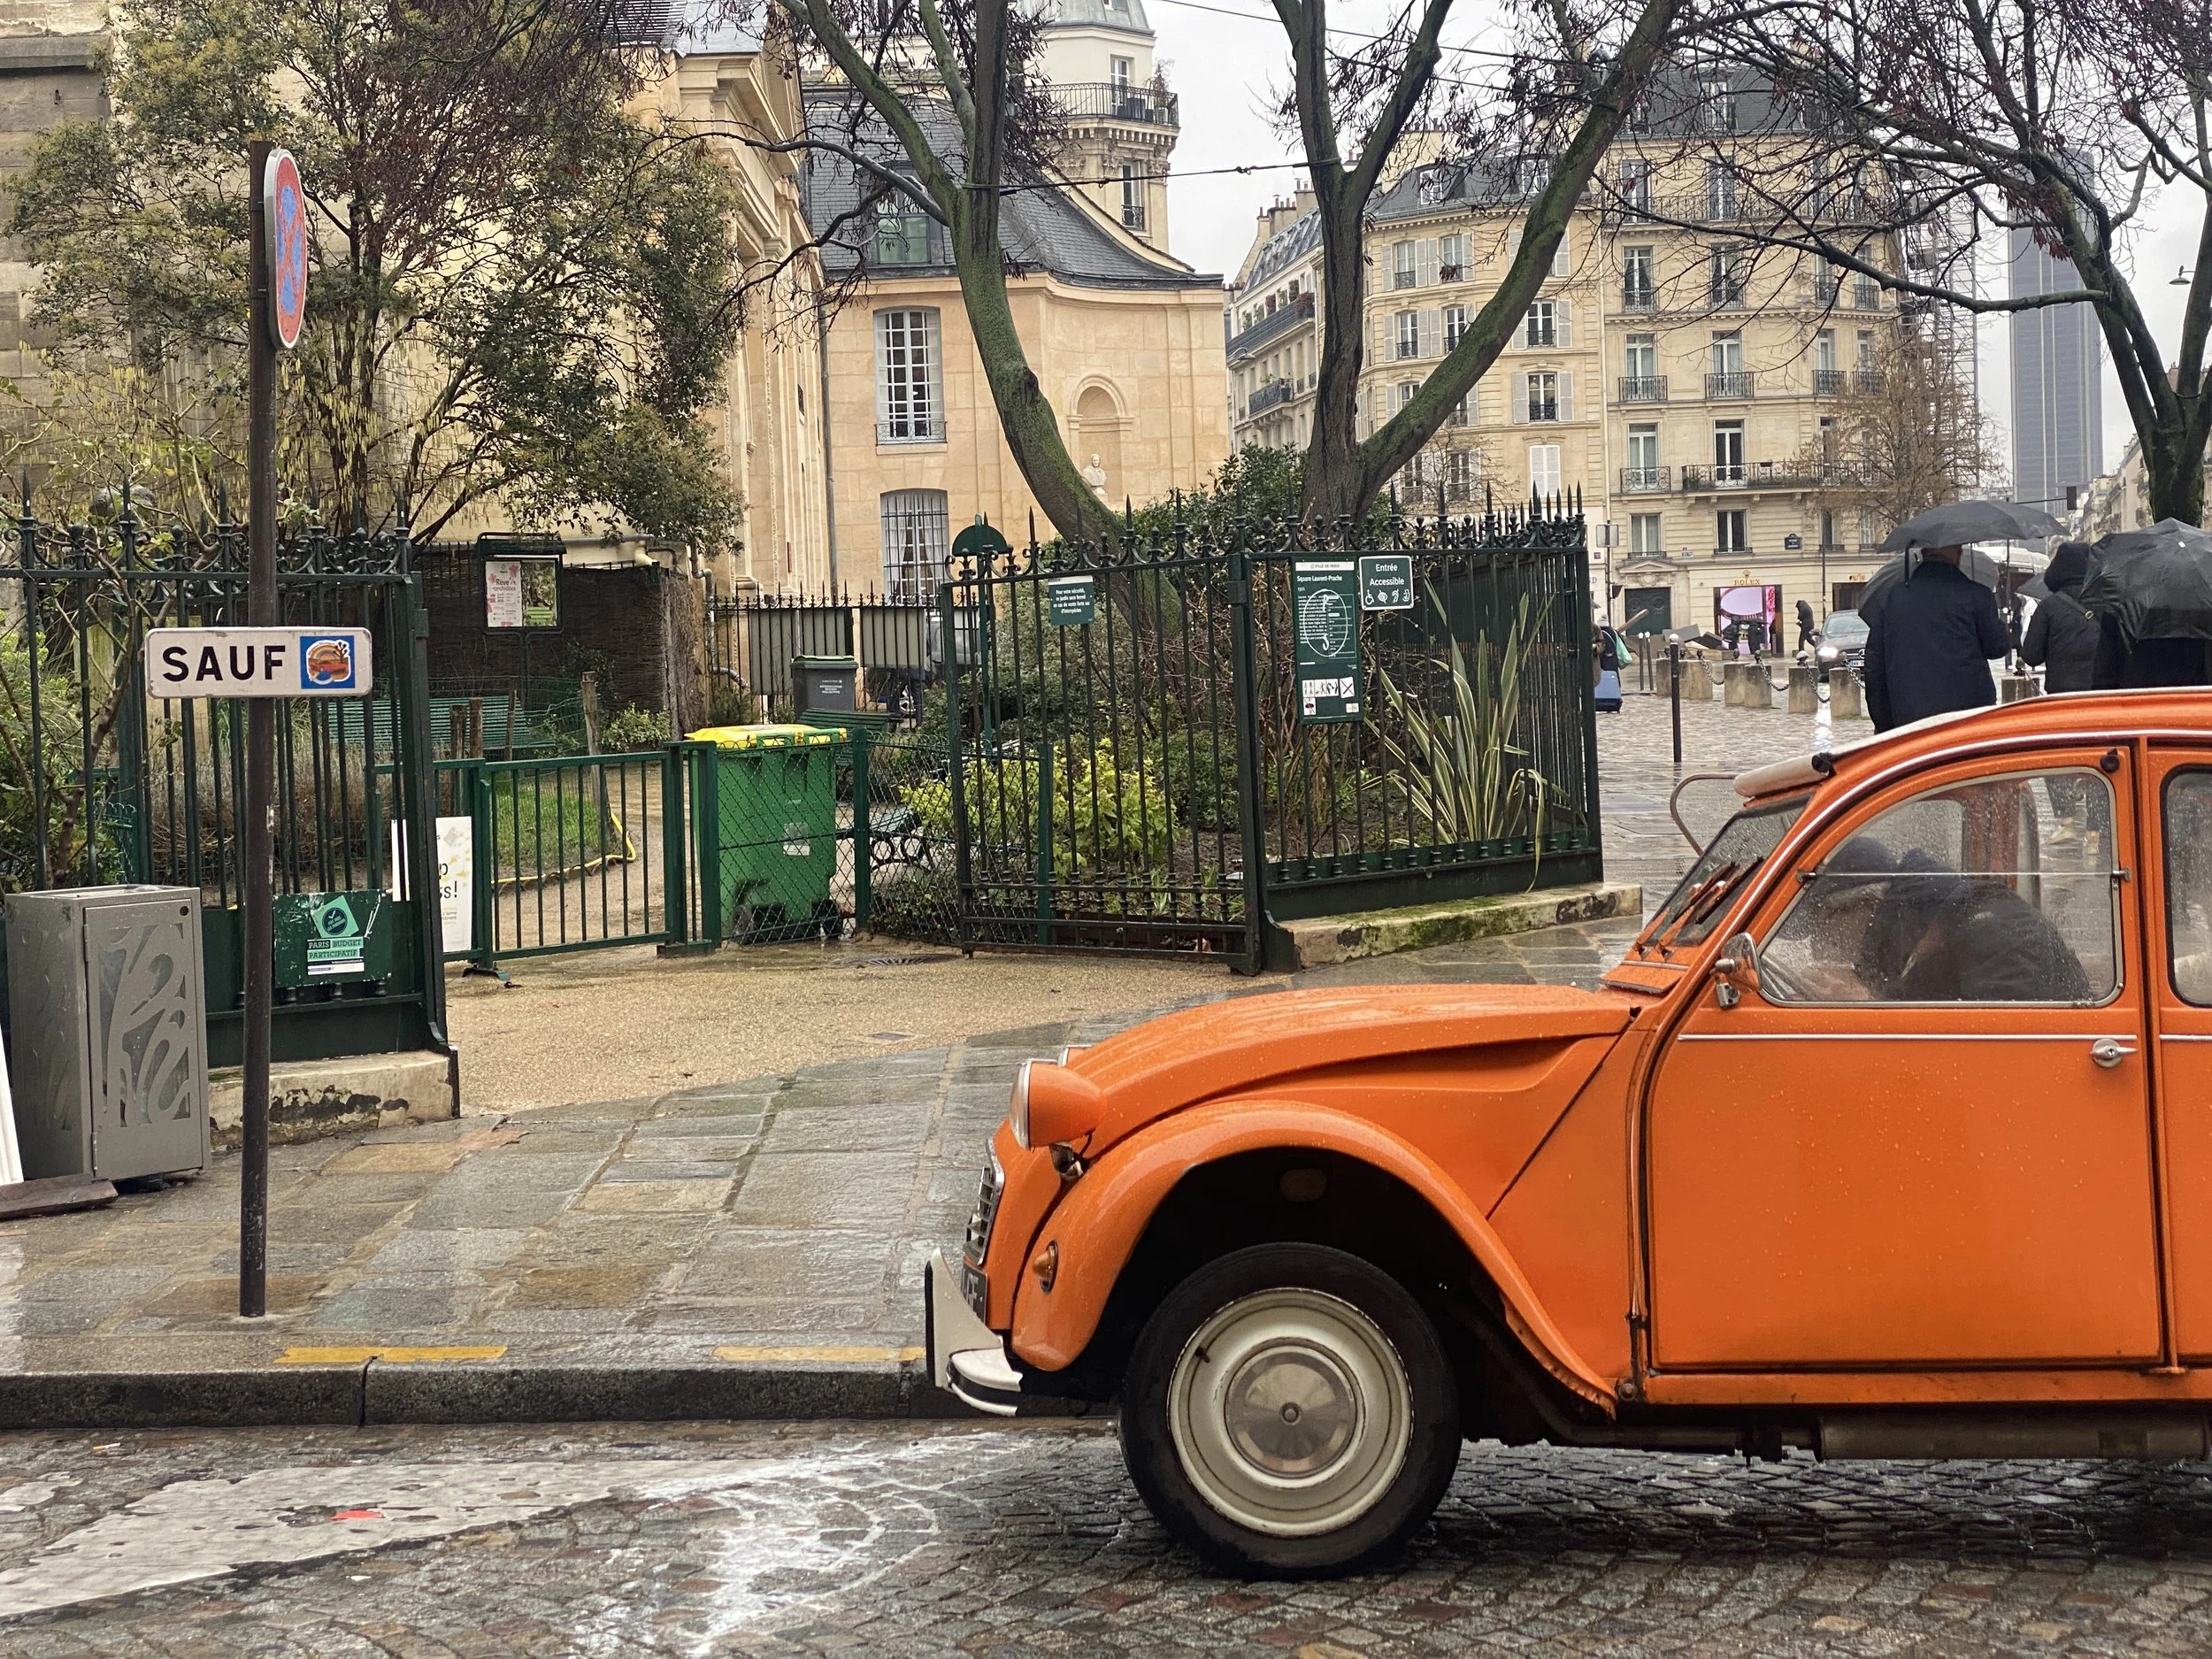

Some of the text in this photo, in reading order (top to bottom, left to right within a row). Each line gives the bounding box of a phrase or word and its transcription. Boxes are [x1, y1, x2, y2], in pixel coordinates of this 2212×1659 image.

[1375, 563, 1398, 572] Entrée
[1370, 577, 1405, 586] Accessible
[162, 645, 286, 682] SAUF
[309, 939, 361, 949] PARIS BUDGET
[309, 949, 357, 959] PARTICIPATIF
